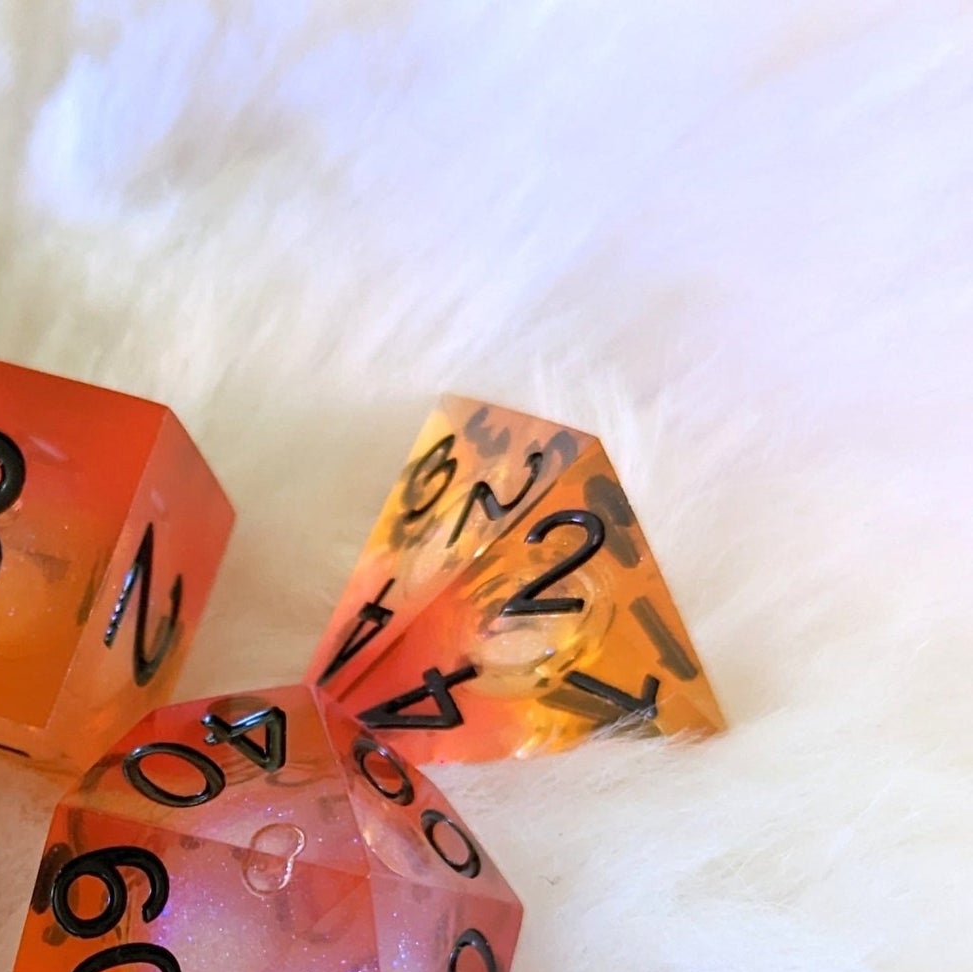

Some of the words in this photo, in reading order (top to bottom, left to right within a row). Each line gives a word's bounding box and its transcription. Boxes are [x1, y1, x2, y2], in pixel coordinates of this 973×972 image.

[500, 509, 605, 617] 2
[317, 578, 394, 686] 4
[355, 665, 478, 730] 4
[122, 706, 286, 807] 40
